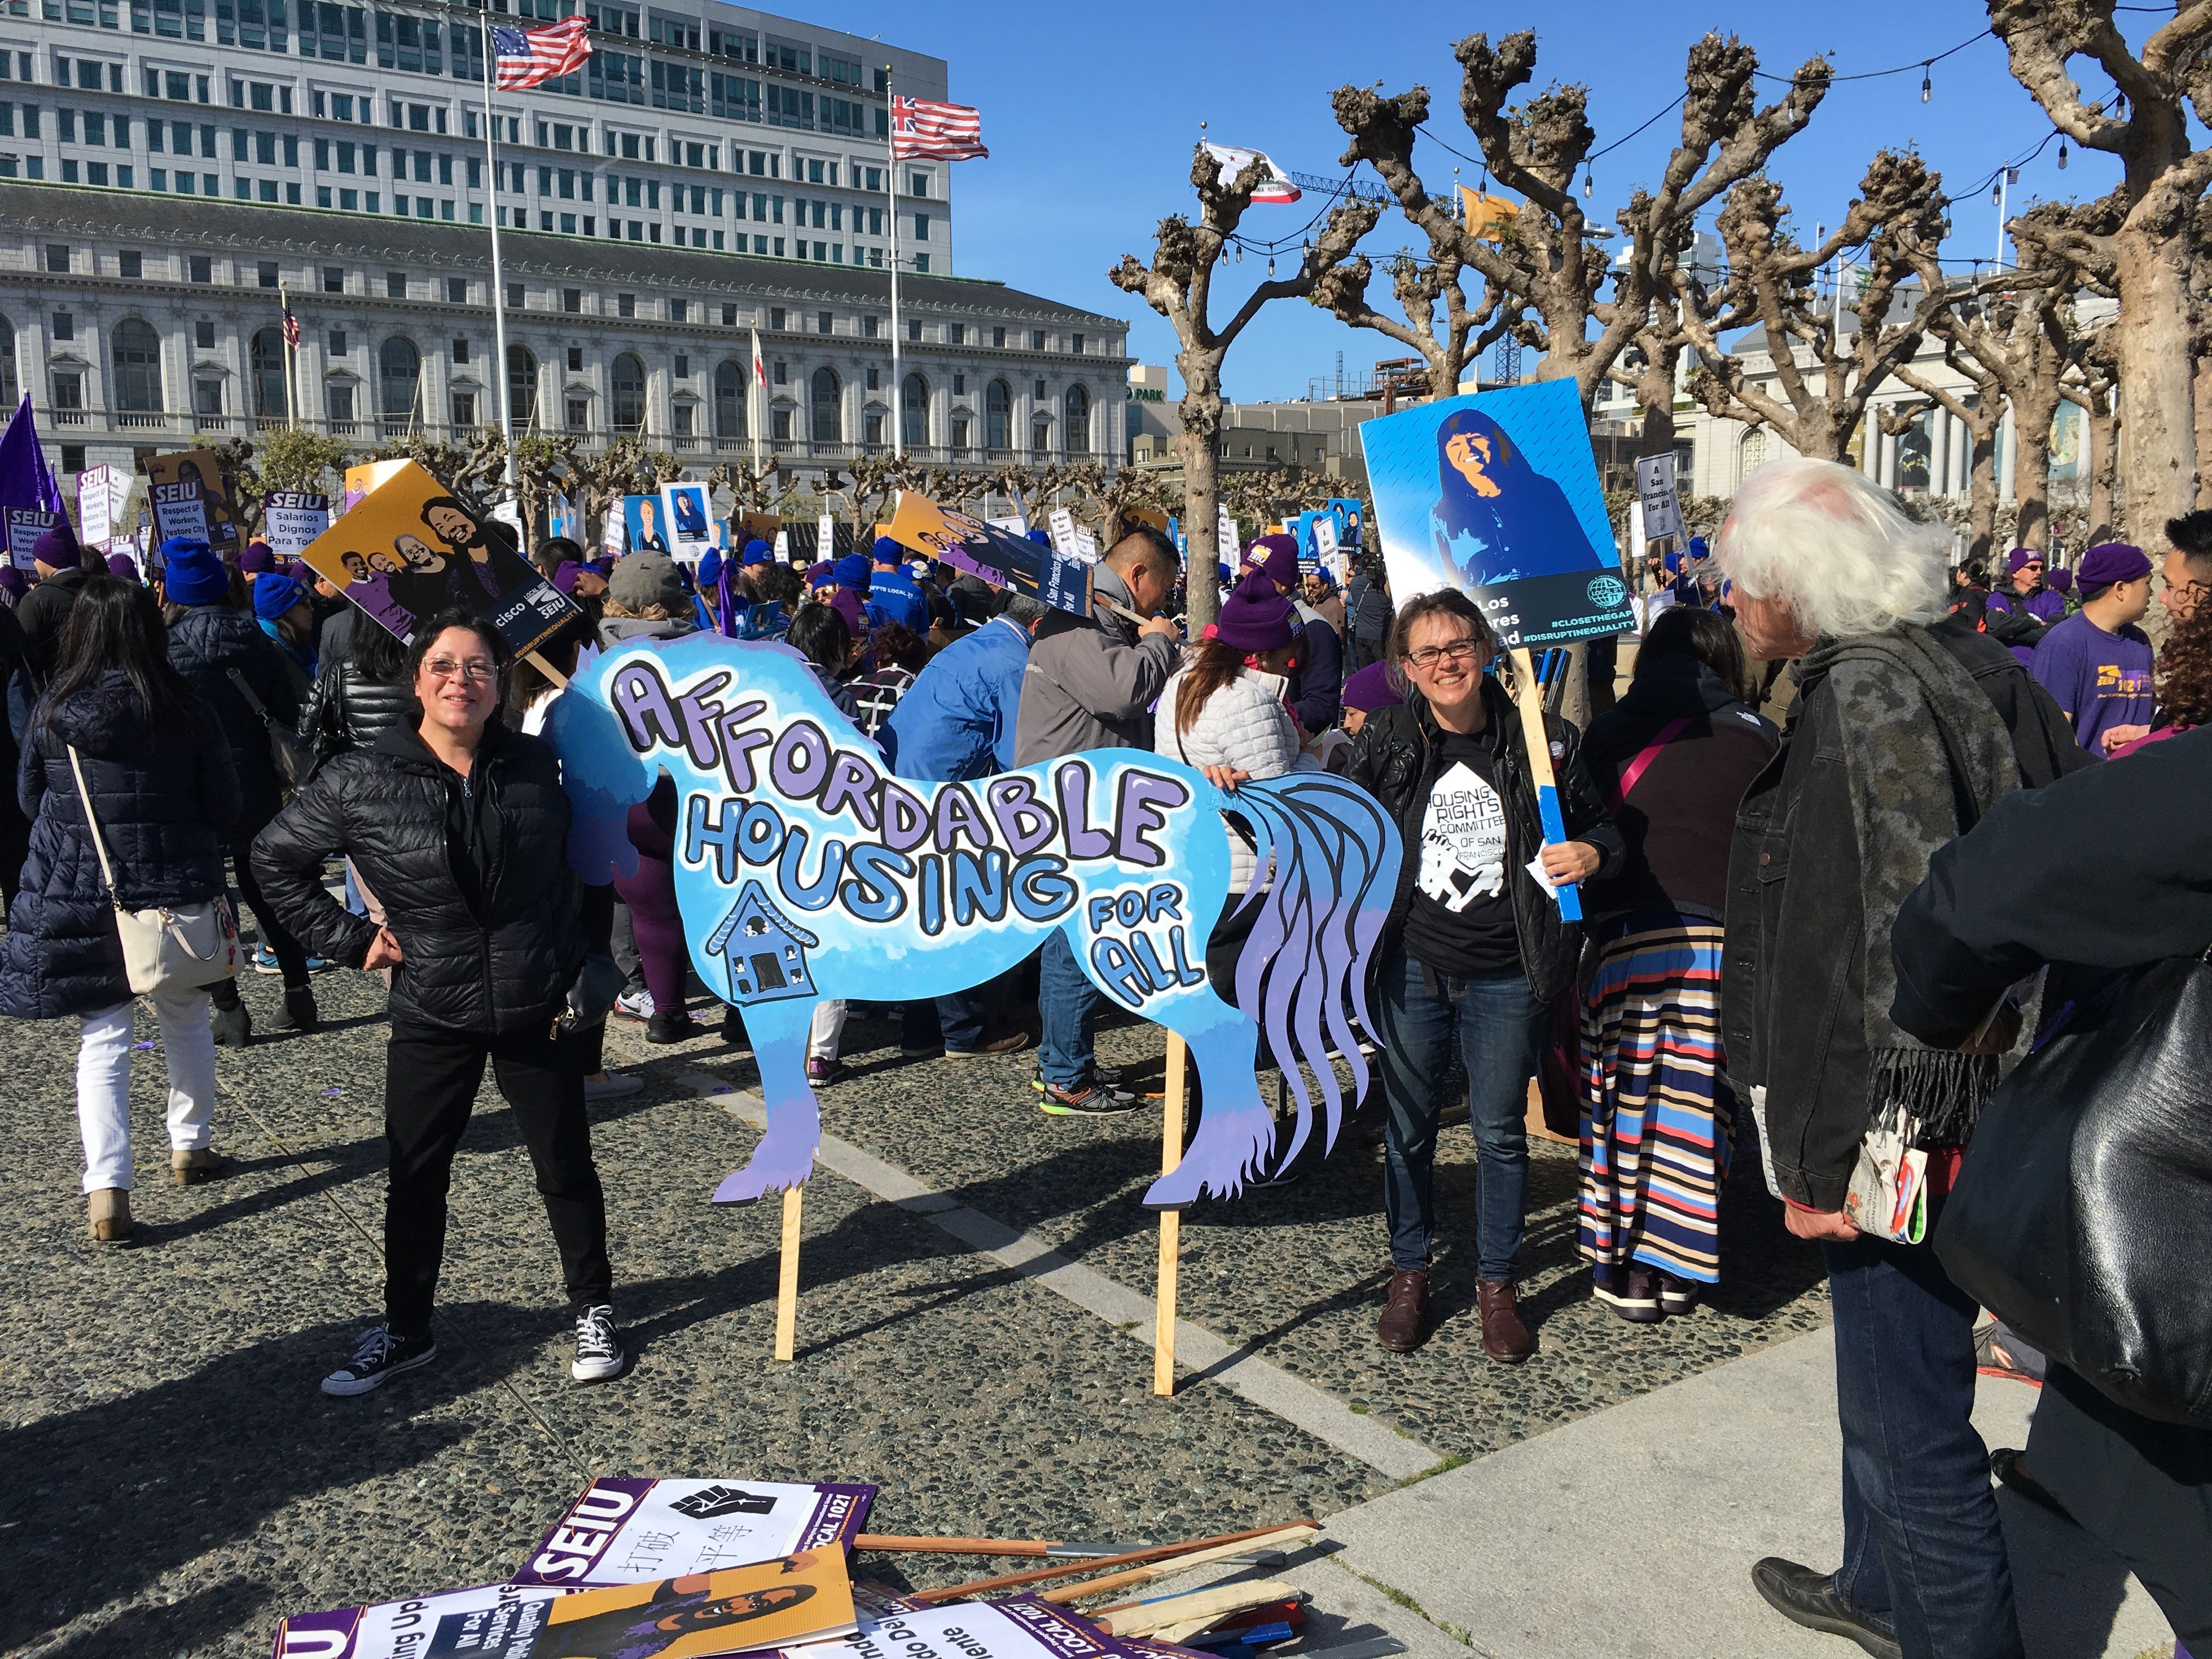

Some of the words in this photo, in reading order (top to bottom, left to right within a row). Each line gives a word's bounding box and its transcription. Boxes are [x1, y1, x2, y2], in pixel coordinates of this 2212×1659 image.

[1136, 388, 1163, 401] PARK
[80, 465, 107, 491] SEIU
[1654, 466, 1660, 474] A
[1650, 478, 1664, 487] San
[82, 490, 100, 501] Respect
[110, 490, 124, 499] cisco
[156, 482, 197, 503] SEIU
[1643, 489, 1669, 501] Francis
[270, 493, 321, 509] SEIU
[611, 499, 624, 514] SEIU
[1648, 504, 1660, 512] For
[1661, 499, 1670, 509] All
[82, 513, 99, 523] Restore
[162, 505, 190, 515] Respect
[276, 512, 318, 522] Salarios
[11, 510, 55, 527] SEIU
[168, 516, 200, 526] Workers,
[87, 522, 105, 532] Services
[193, 526, 206, 534] City
[279, 524, 317, 534] Dignos
[1076, 524, 1091, 536] SEIU
[111, 534, 129, 545] EIU
[268, 535, 292, 545] Para
[295, 537, 315, 546] Tod
[1248, 552, 1266, 563] SEIU
[1321, 547, 1336, 558] Francisco
[1048, 561, 1062, 590] Francisco
[523, 587, 540, 600] LOCAL
[538, 580, 548, 590] 1021
[888, 588, 906, 596] LOCAL
[1047, 588, 1059, 601] San
[1064, 591, 1075, 603] All
[541, 597, 566, 619] SEIU
[1063, 601, 1075, 613] For
[1477, 596, 1509, 613] Los
[495, 602, 526, 629] cisco
[1551, 610, 1633, 629] #CLOSETHEGAP
[514, 608, 578, 659] #DISRUPTINEQUALITY
[1292, 623, 1305, 637] SEIU
[1523, 619, 1635, 644] #DISRUPTINEQUALITY
[2097, 678, 2115, 686] SEIU
[611, 659, 1190, 868] AFFORDABLE
[1436, 798, 1499, 823] RIGHTS
[1439, 815, 1506, 834] COMMITTEE
[1460, 837, 1474, 848] OF
[1477, 836, 1501, 847] SAN
[1459, 847, 1505, 860] FRANCISCO
[685, 794, 1080, 936] HOUSING
[1087, 881, 1184, 935] FOR
[1090, 924, 1207, 1008] ALL
[827, 1494, 851, 1519] 1021
[533, 1488, 633, 1578] SEIU
[617, 1531, 680, 1573] 打破
[391, 1601, 429, 1630] Up
[510, 1601, 545, 1638] Quality
[1007, 1603, 1048, 1620] 1021
[462, 1611, 488, 1631] For
[482, 1606, 517, 1650] Services
[1008, 1612, 1037, 1631] International
[873, 1618, 917, 1641] Del
[1035, 1629, 1059, 1646] Employees
[1039, 1620, 1097, 1654] LOCAL
[455, 1633, 481, 1649] All
[1057, 1645, 1075, 1658] Service
